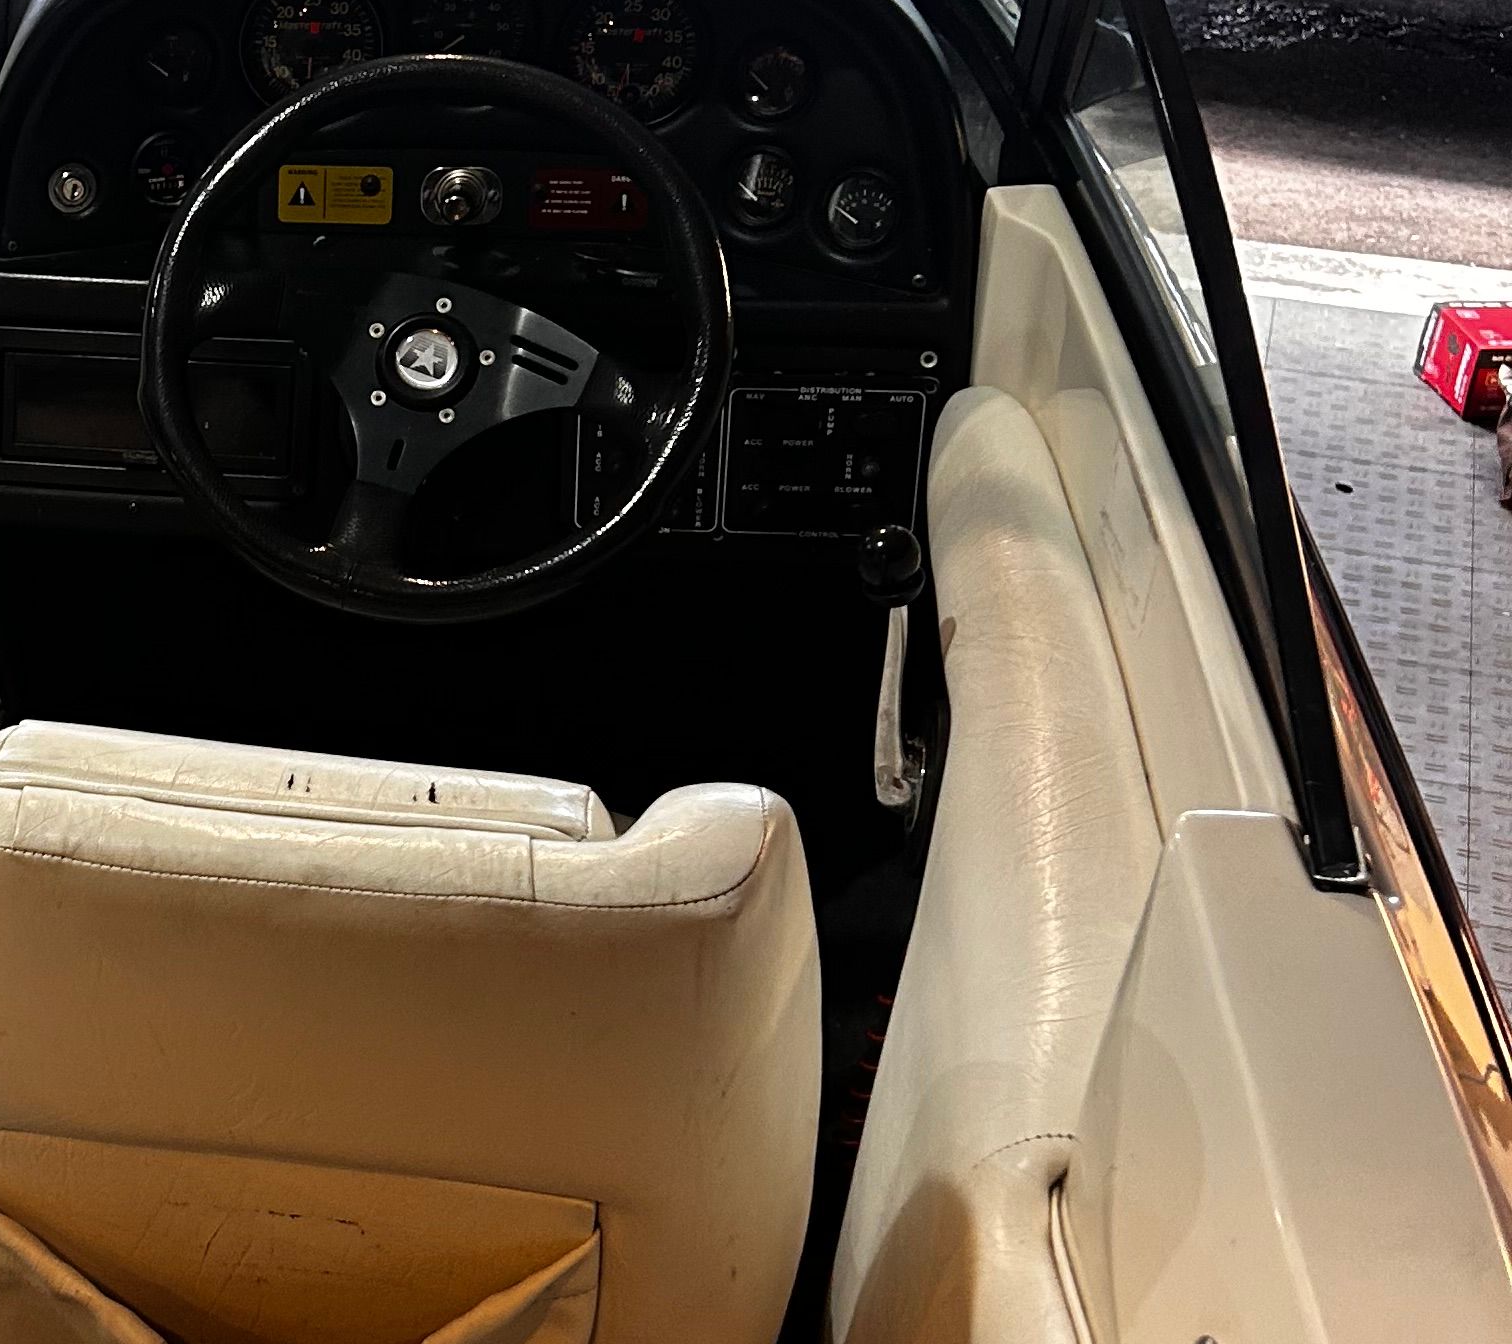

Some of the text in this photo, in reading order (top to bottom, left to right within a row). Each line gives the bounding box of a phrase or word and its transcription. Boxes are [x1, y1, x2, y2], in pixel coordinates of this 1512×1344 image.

[276, 5, 295, 19] 20
[330, 1, 350, 15] 30
[623, 0, 644, 12] 25
[650, 7, 672, 21] 30
[343, 23, 362, 37] 35
[664, 29, 684, 43] 35
[262, 35, 277, 48] 15
[580, 41, 596, 55] 15
[342, 49, 362, 61] 40
[661, 55, 683, 69] 40
[591, 72, 606, 85] 10
[653, 72, 674, 86] 45
[800, 386, 862, 395] DISTRIBUTION
[889, 395, 915, 403] AUTO
[782, 439, 814, 447] POWER
[778, 484, 811, 493] POWER
[834, 486, 873, 494] BLOWER
